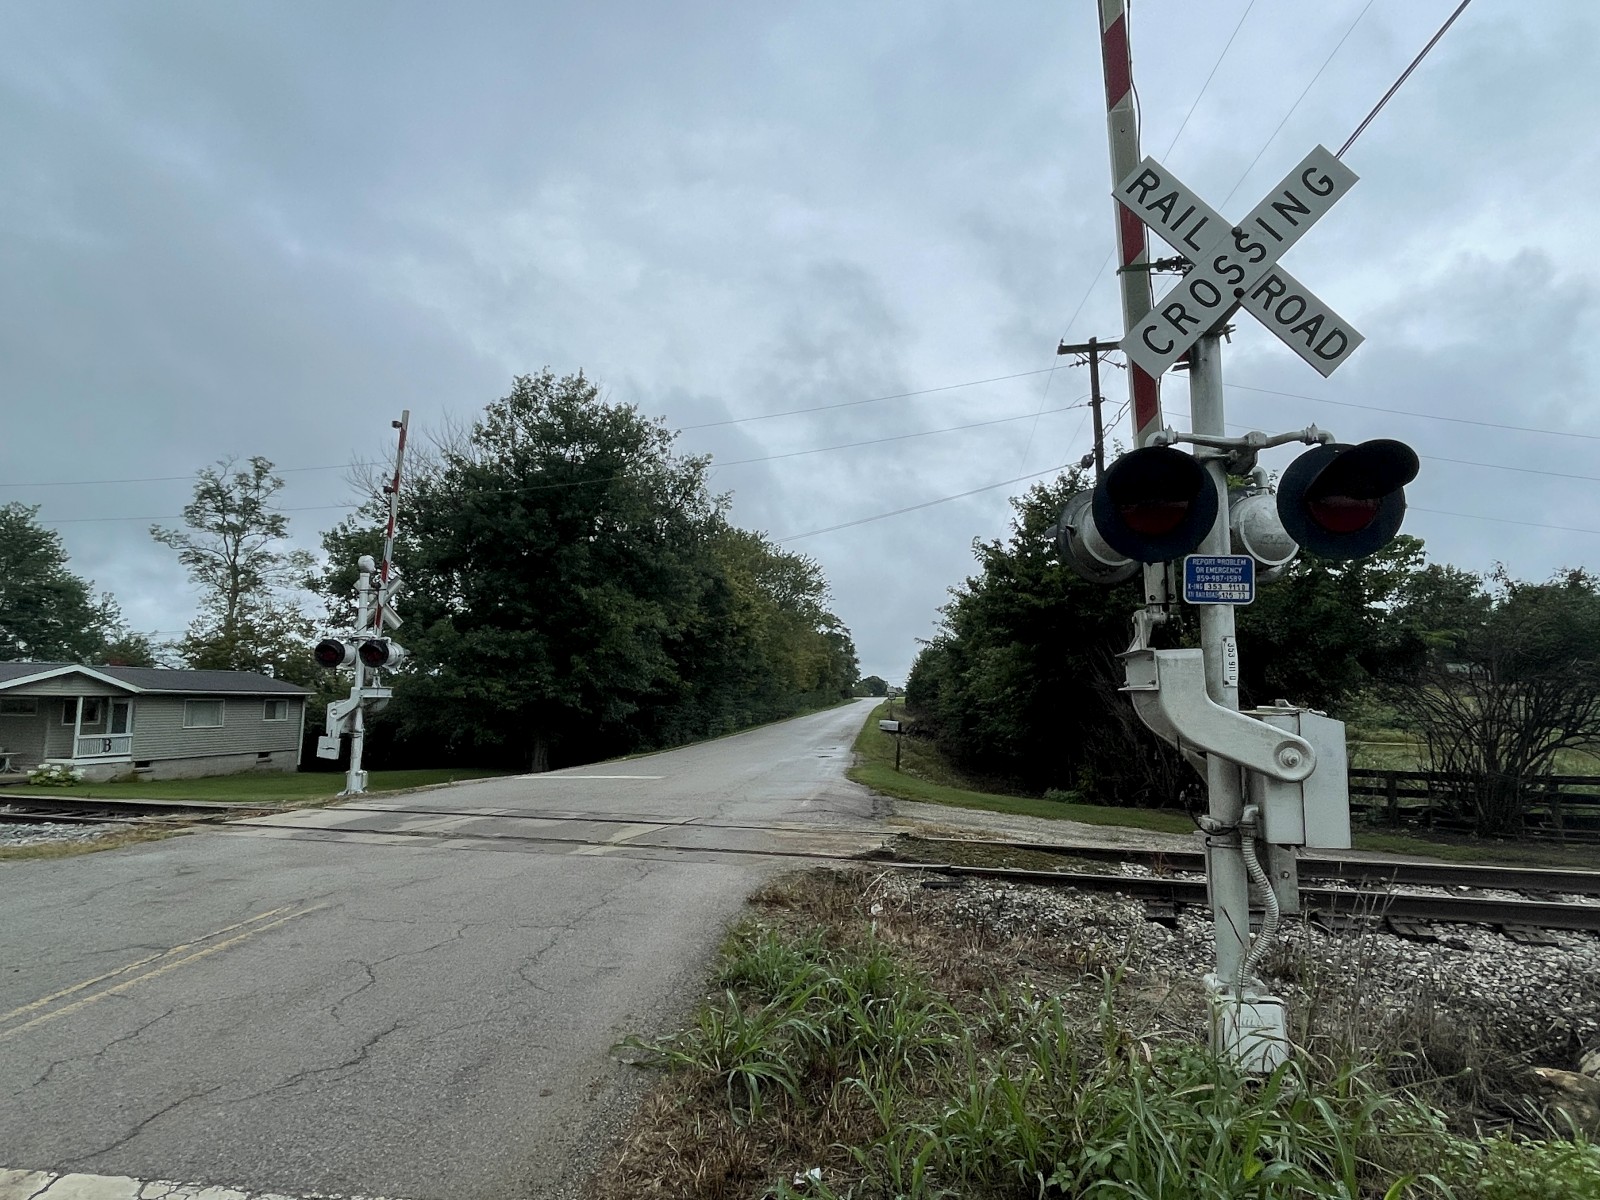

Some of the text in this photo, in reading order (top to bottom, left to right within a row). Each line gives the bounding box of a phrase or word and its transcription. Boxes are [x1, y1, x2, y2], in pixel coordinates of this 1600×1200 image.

[1125, 168, 1348, 361] RAIL ROAD
[1142, 167, 1335, 356] CROSSING
[1217, 558, 1247, 566] PROBLEM
[1195, 566, 1243, 574] OR EMERGENCY
[1228, 642, 1236, 658] 353
[1228, 661, 1236, 672] 911
[101, 738, 112, 753] B
